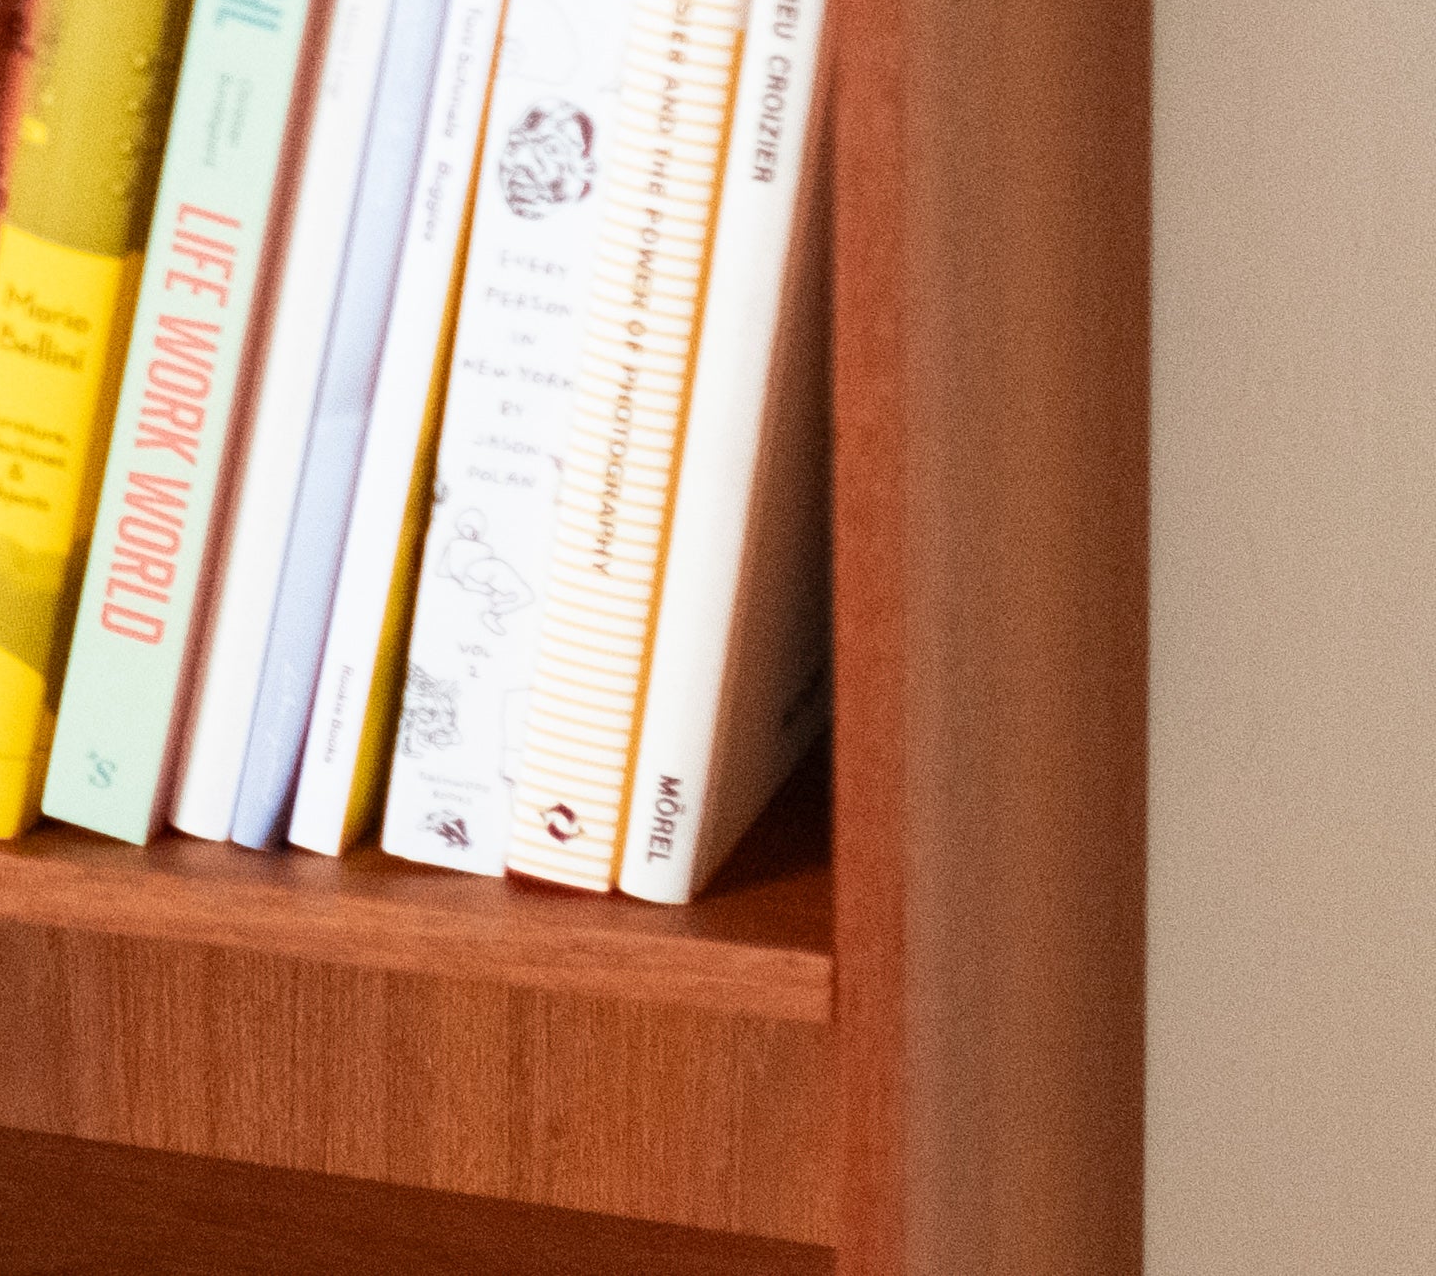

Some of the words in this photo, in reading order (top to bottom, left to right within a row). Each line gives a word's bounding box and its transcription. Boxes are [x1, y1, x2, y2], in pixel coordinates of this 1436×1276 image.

[658, 76, 679, 135] AND
[753, 55, 792, 183] CROIZIER
[644, 148, 672, 199] THE
[163, 201, 242, 308] LIFE
[500, 250, 570, 280] EVERY
[631, 208, 661, 308] POWER
[485, 285, 573, 317] PERSON
[624, 319, 647, 351] OF
[134, 313, 224, 465] WORK
[463, 360, 509, 378] NEW
[519, 364, 574, 391] YORK
[500, 400, 524, 417] BY
[473, 431, 542, 457] JASON
[466, 464, 537, 489] POLAN
[592, 366, 636, 576] PHOTOGRAPHY
[100, 471, 192, 646] WORLD
[324, 718, 344, 765] Books
